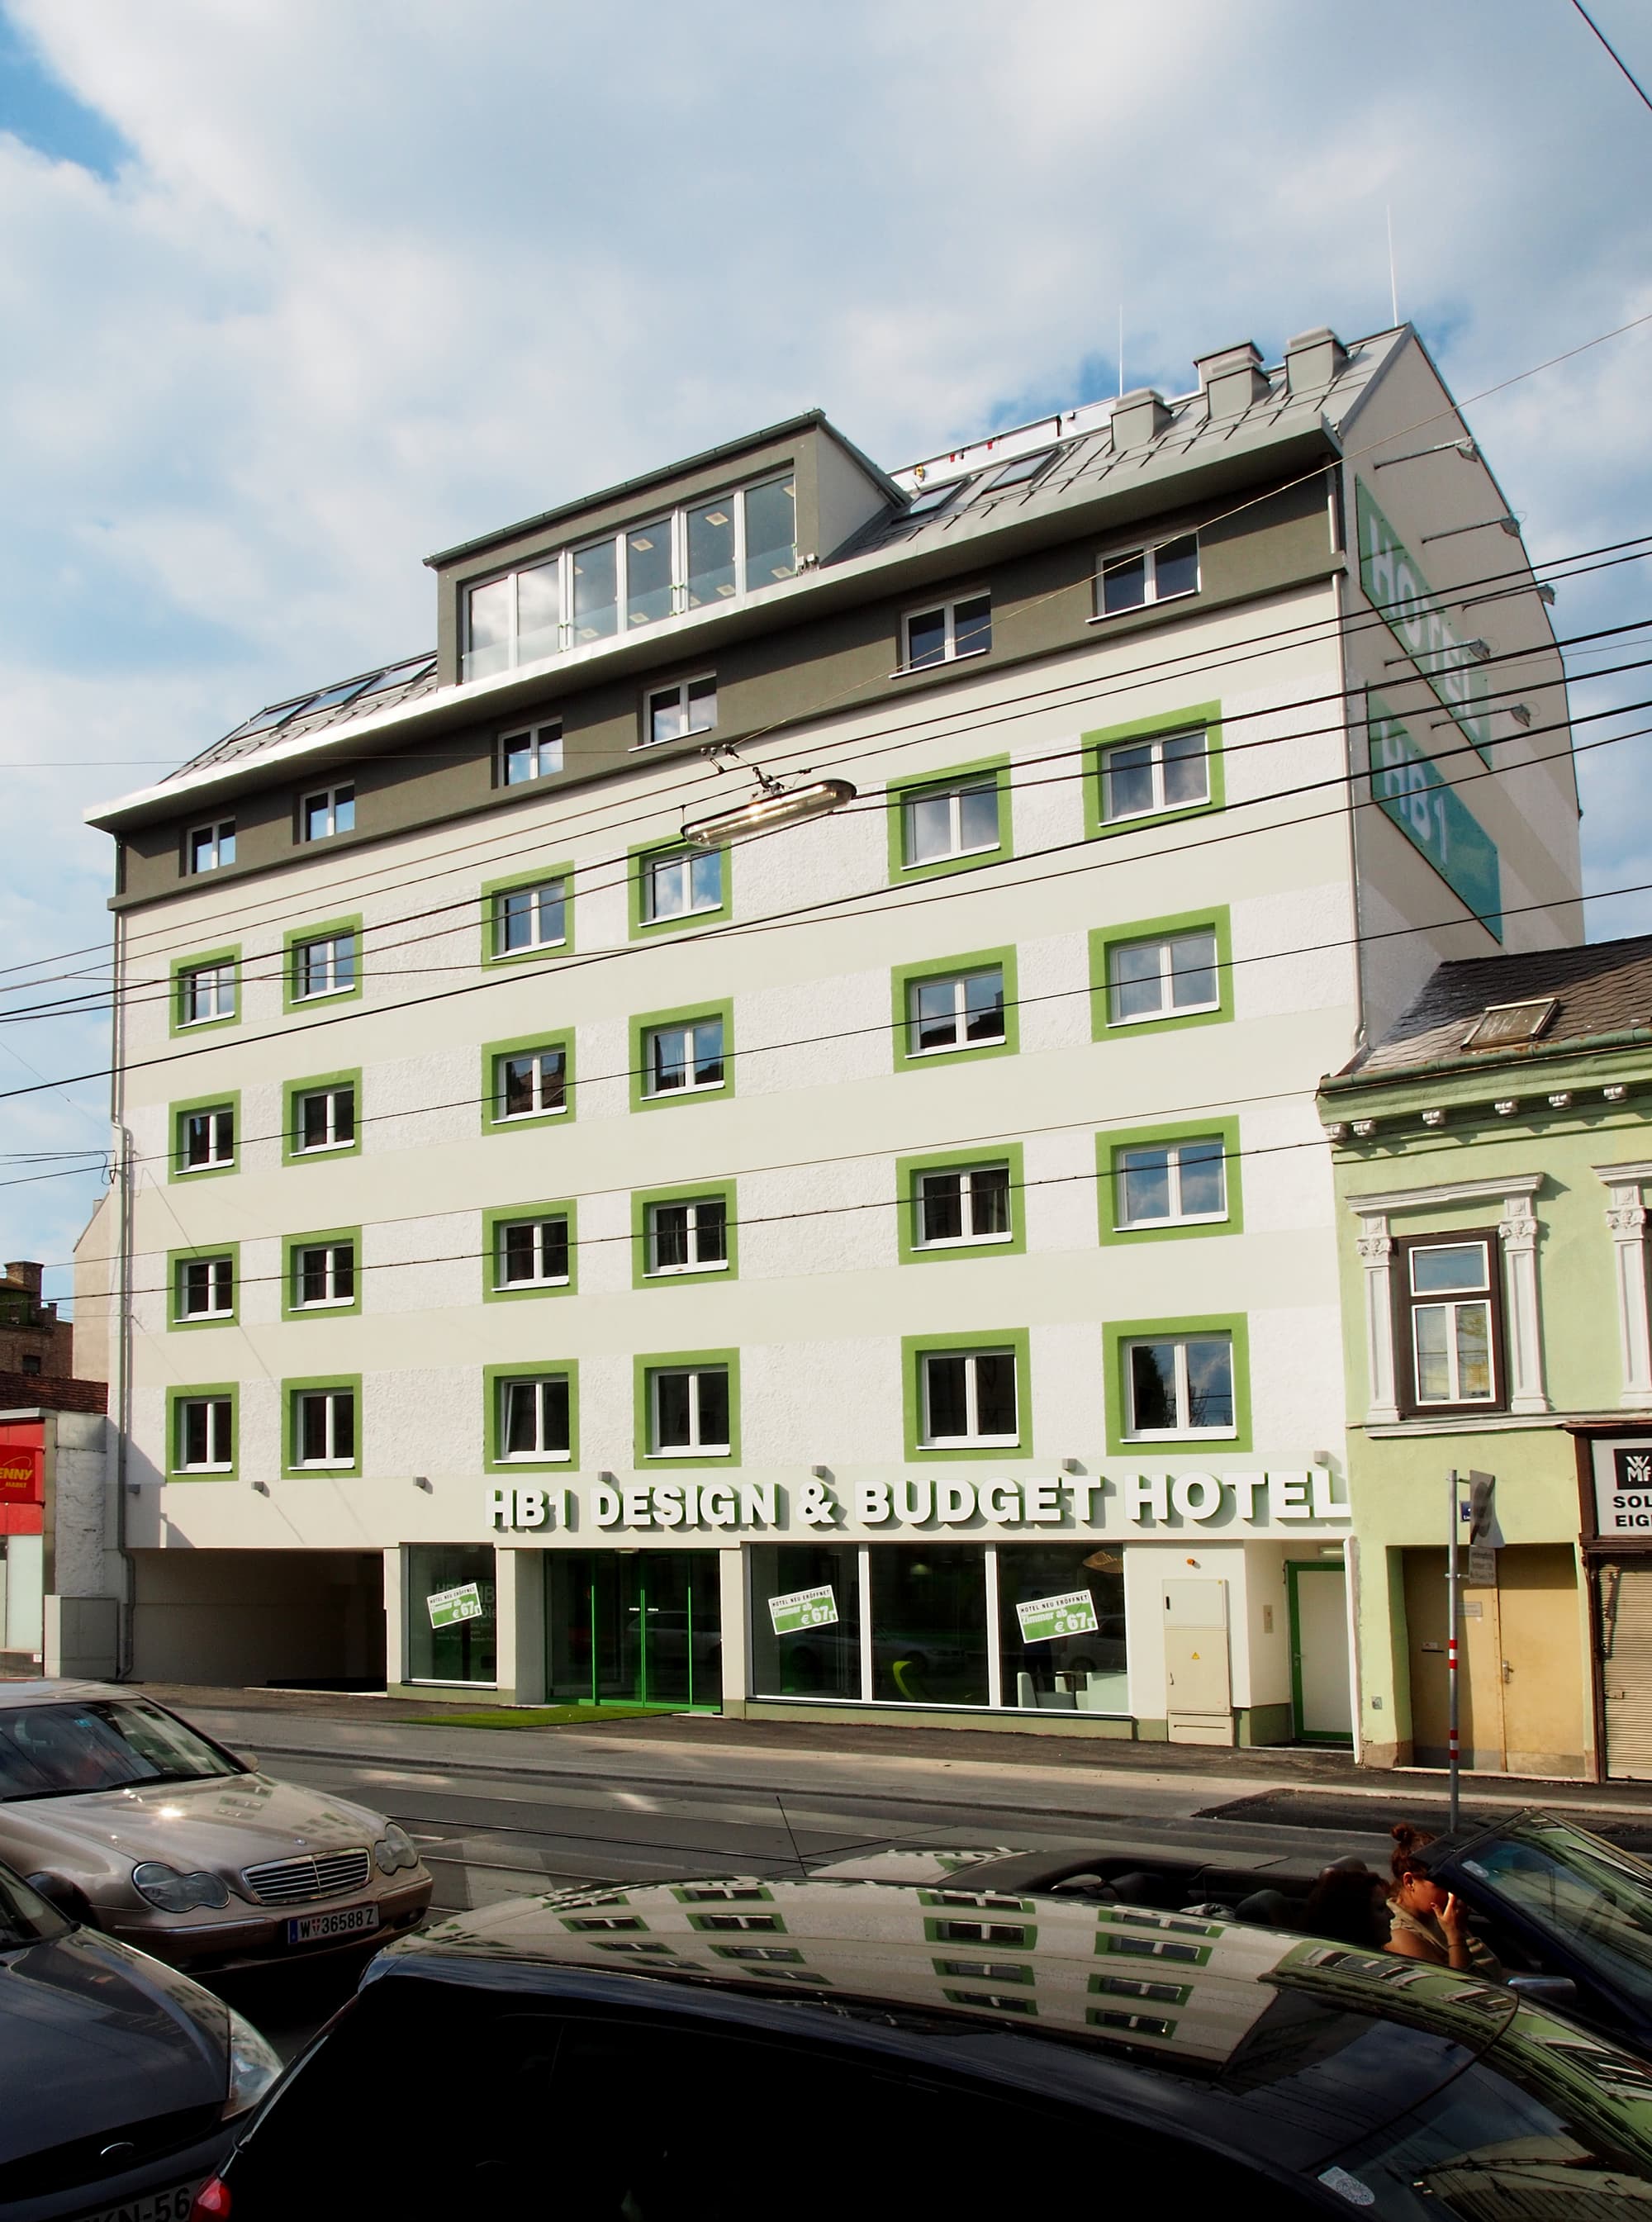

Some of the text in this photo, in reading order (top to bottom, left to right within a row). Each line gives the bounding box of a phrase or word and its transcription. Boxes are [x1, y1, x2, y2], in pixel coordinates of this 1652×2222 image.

[1369, 513, 1480, 738] HOTEL
[1380, 720, 1447, 866] HB1
[485, 1470, 1352, 1528] HB1 DESIGN & BUDGET HOTEL
[1615, 1514, 1652, 1526] EIG
[1021, 1594, 1088, 1613] HOTEL NEU ERÖFFNET
